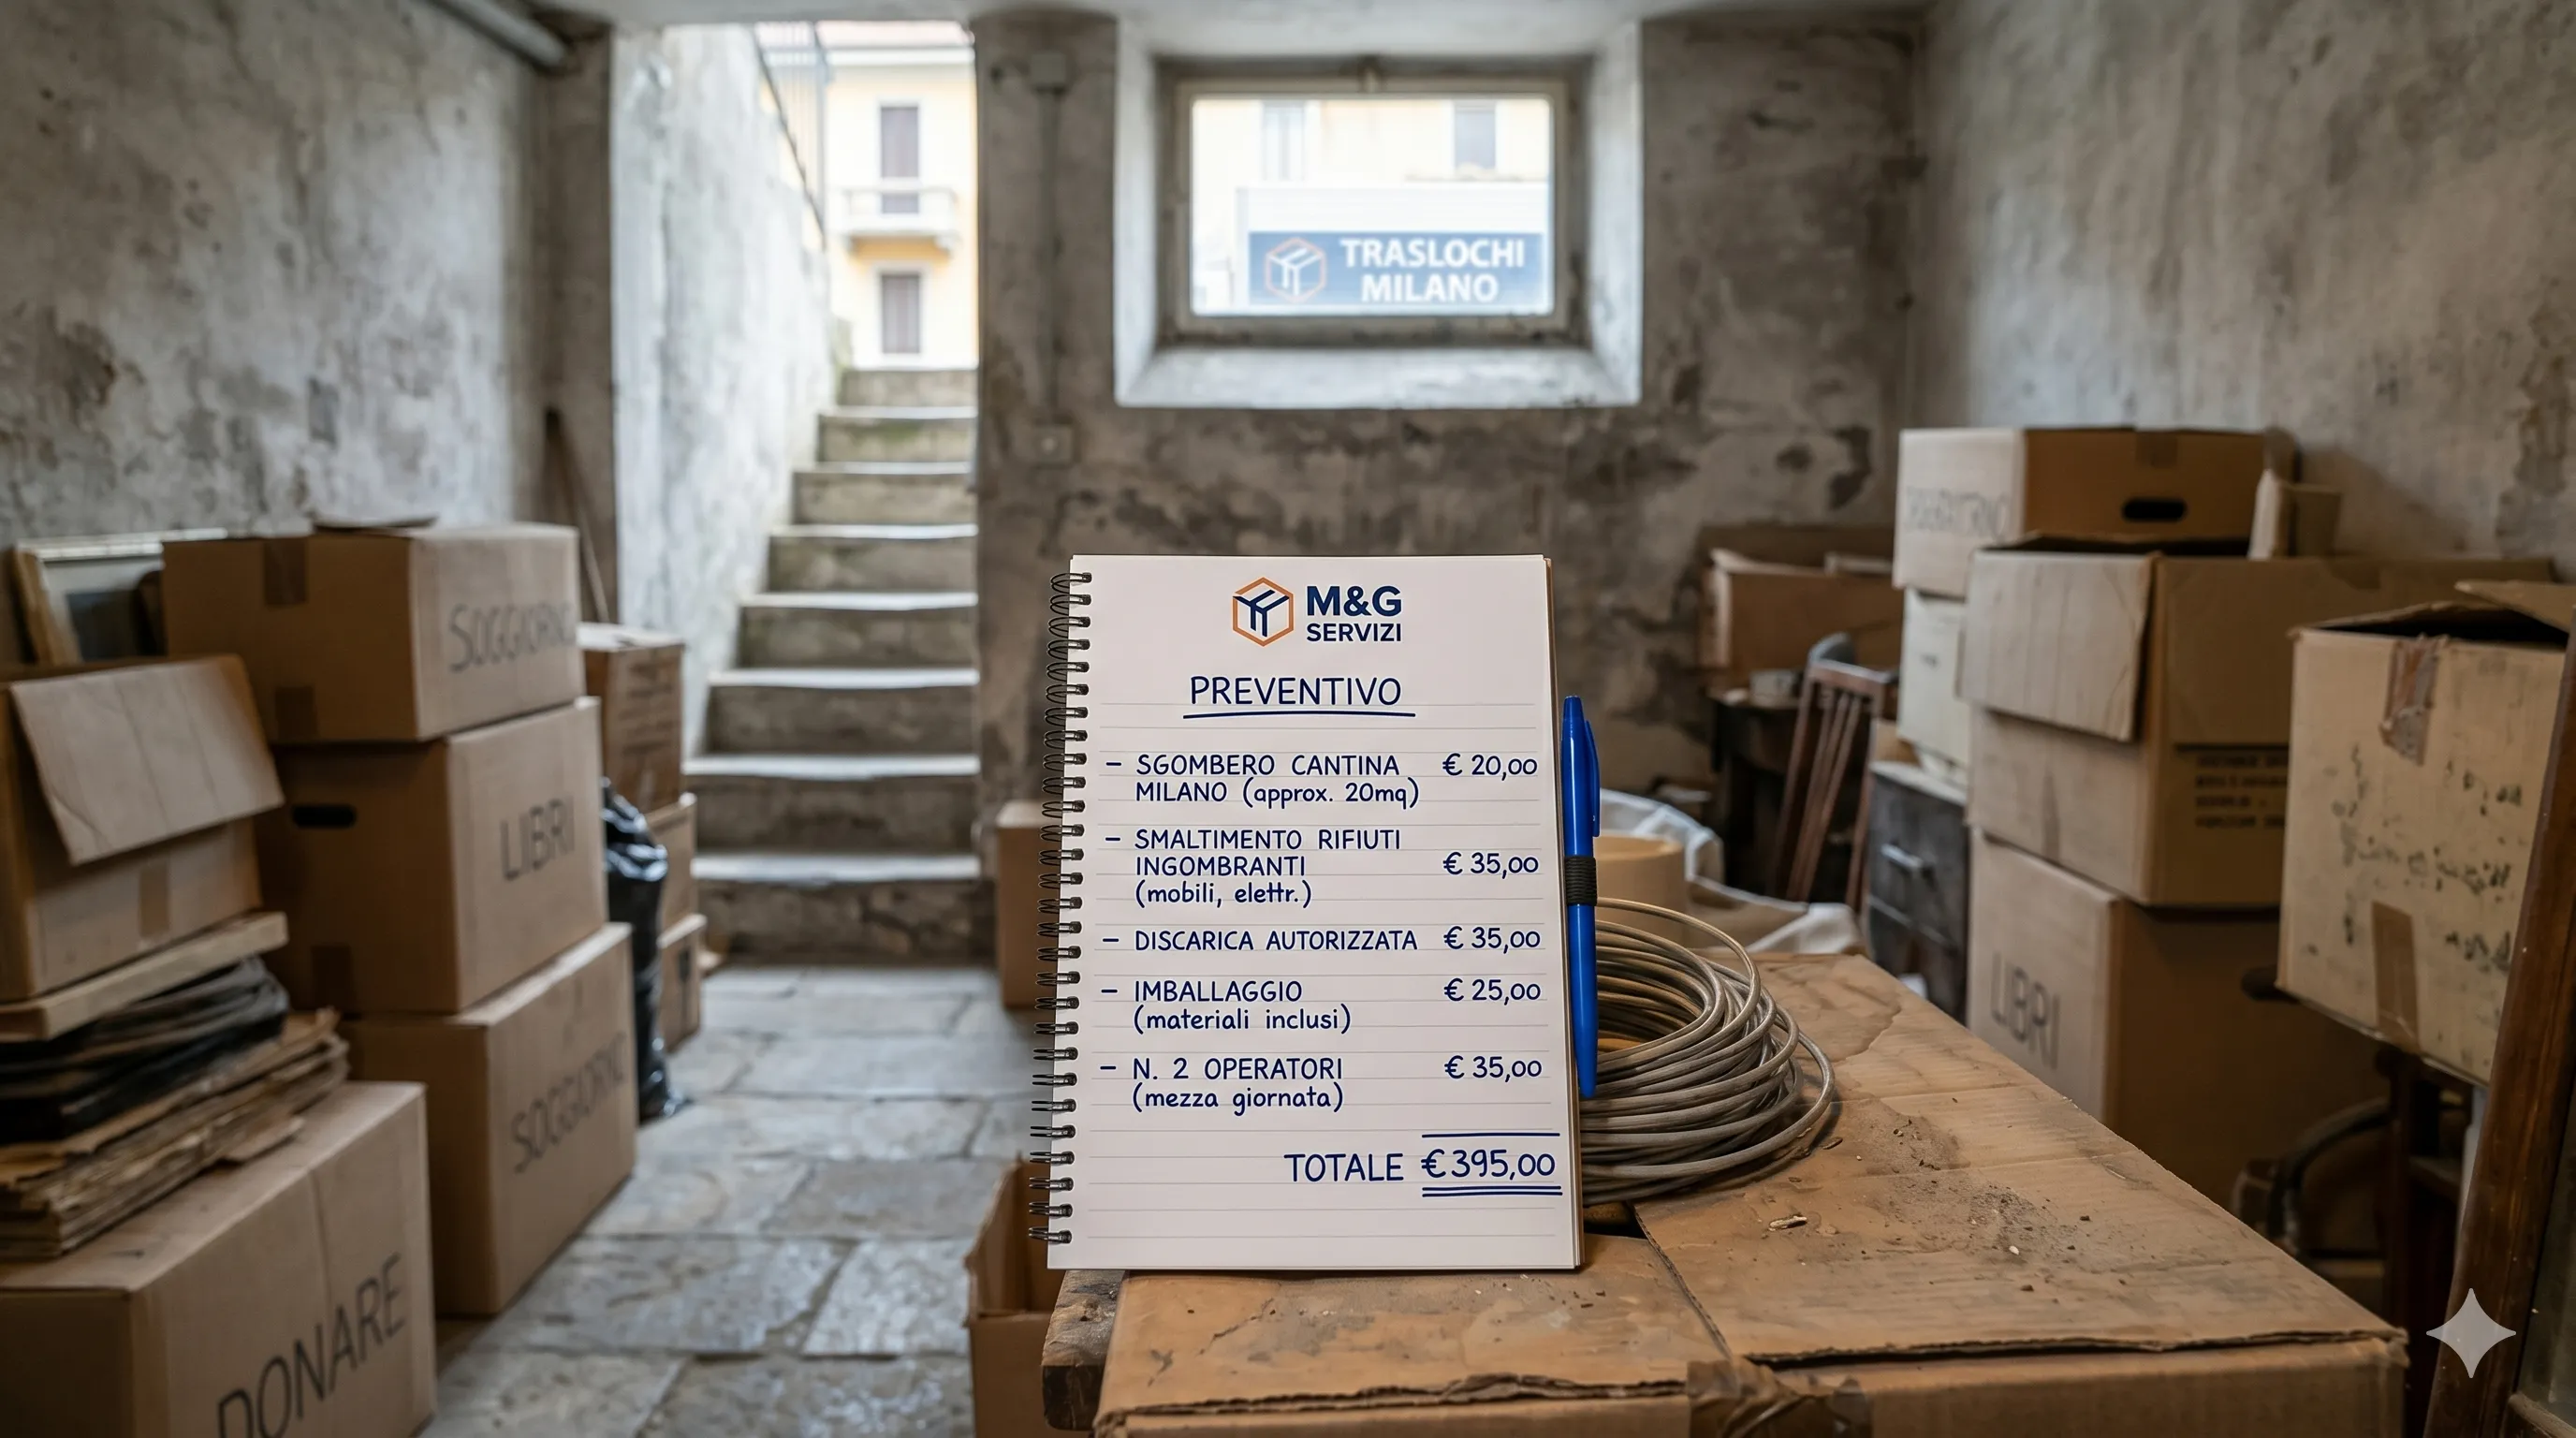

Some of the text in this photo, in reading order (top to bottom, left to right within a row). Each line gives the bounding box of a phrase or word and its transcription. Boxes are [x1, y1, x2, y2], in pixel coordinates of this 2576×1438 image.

[1339, 238, 1525, 269] TRASLOCHI
[1361, 273, 1499, 303] MILANO
[1307, 585, 1402, 617] M&G
[1306, 623, 1401, 642] SERVIZI
[1190, 675, 1402, 706] PREVENTIVO
[1136, 754, 1275, 776] SGOMBERO
[1291, 755, 1400, 776] CANTINA
[1442, 752, 1463, 776] €
[1471, 754, 1538, 782] 20,00
[1135, 776, 1419, 810] MILANO (approx. 20mq)
[500, 798, 575, 880] LIBRI
[1134, 829, 1302, 850] SMALTIMENTO
[1318, 829, 1400, 850] RIFIUTI
[1136, 851, 1539, 880] INGOMBRANTI € 35,00
[1135, 879, 1311, 909] (mobili, elettr.)
[1135, 930, 1254, 951] DISCARICA
[1266, 930, 1418, 951] AUTORIZZATA
[1442, 925, 1464, 950] €
[1471, 926, 1541, 955] 35,00
[1134, 979, 1302, 1003] IMBALLAGGIO
[1443, 977, 1465, 1002] €
[1471, 978, 1542, 1006] 25,00
[1134, 1003, 1351, 1035] (materiali inclusi)
[1991, 953, 2059, 1068] LIBRI
[1133, 1057, 1158, 1080] N.
[1173, 1057, 1189, 1079] 2
[1204, 1057, 1342, 1080] OPERATORI
[1443, 1054, 1465, 1079] €
[1472, 1055, 1543, 1083] 35,00
[1133, 1081, 1343, 1117] (mezza giornata)
[1283, 1152, 1404, 1182] TOTALE
[217, 1253, 405, 1438] DONARE
